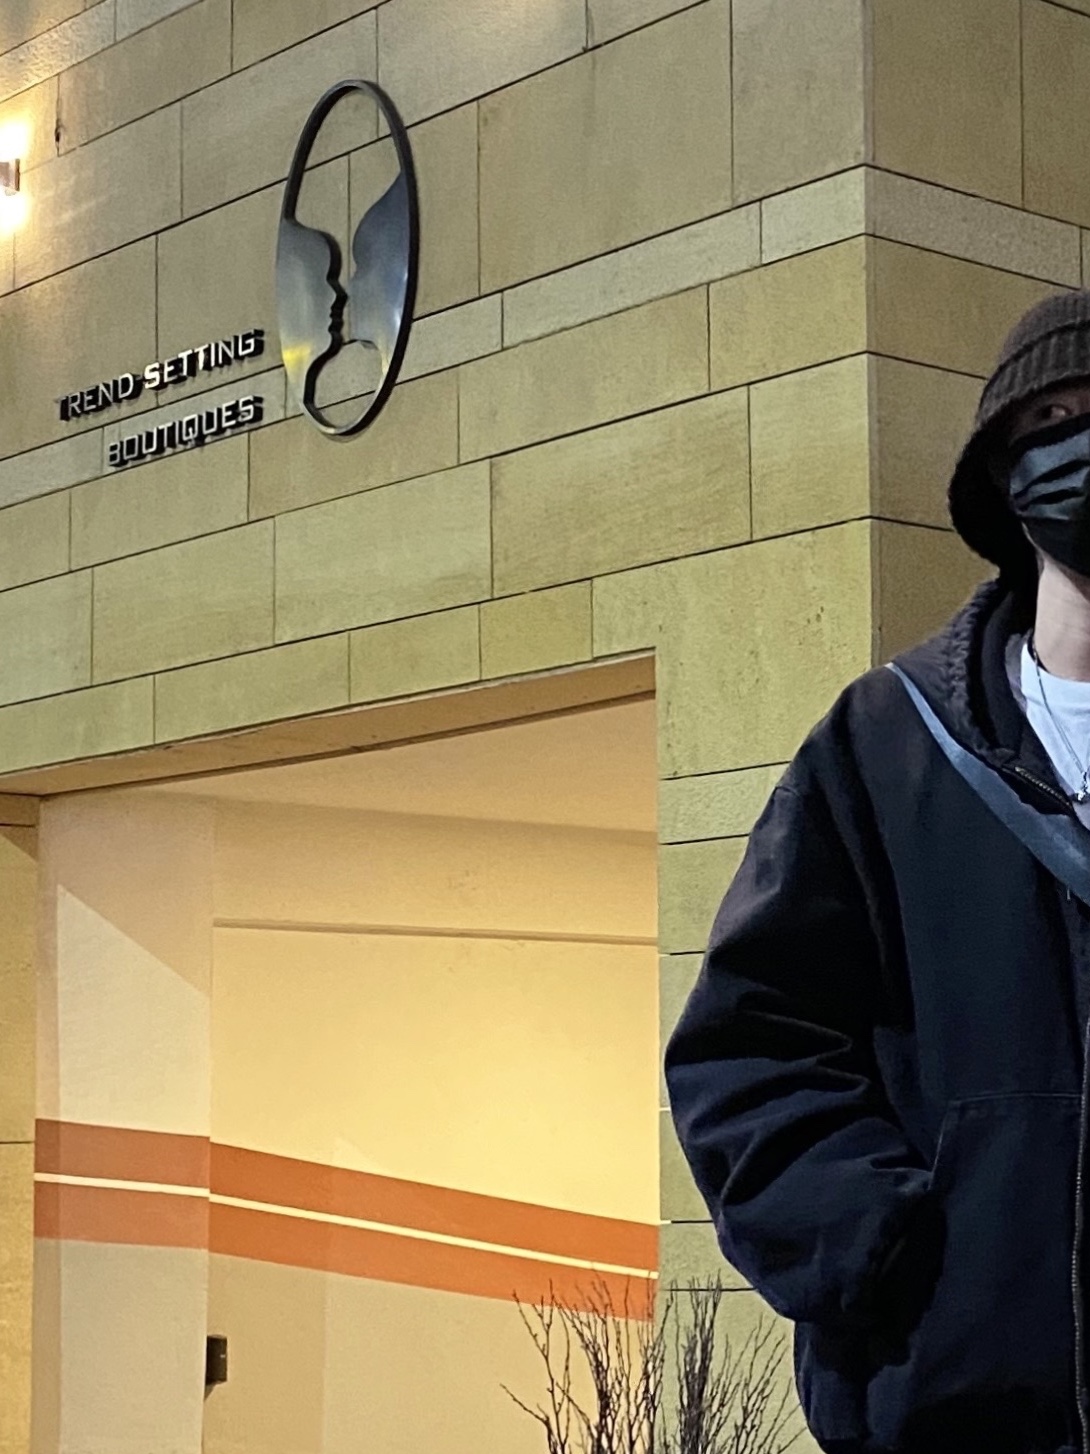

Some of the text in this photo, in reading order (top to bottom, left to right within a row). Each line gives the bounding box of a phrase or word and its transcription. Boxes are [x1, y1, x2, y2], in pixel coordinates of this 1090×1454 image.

[55, 329, 263, 420] TREND SETTING
[108, 395, 262, 467] BOUTIQUES
